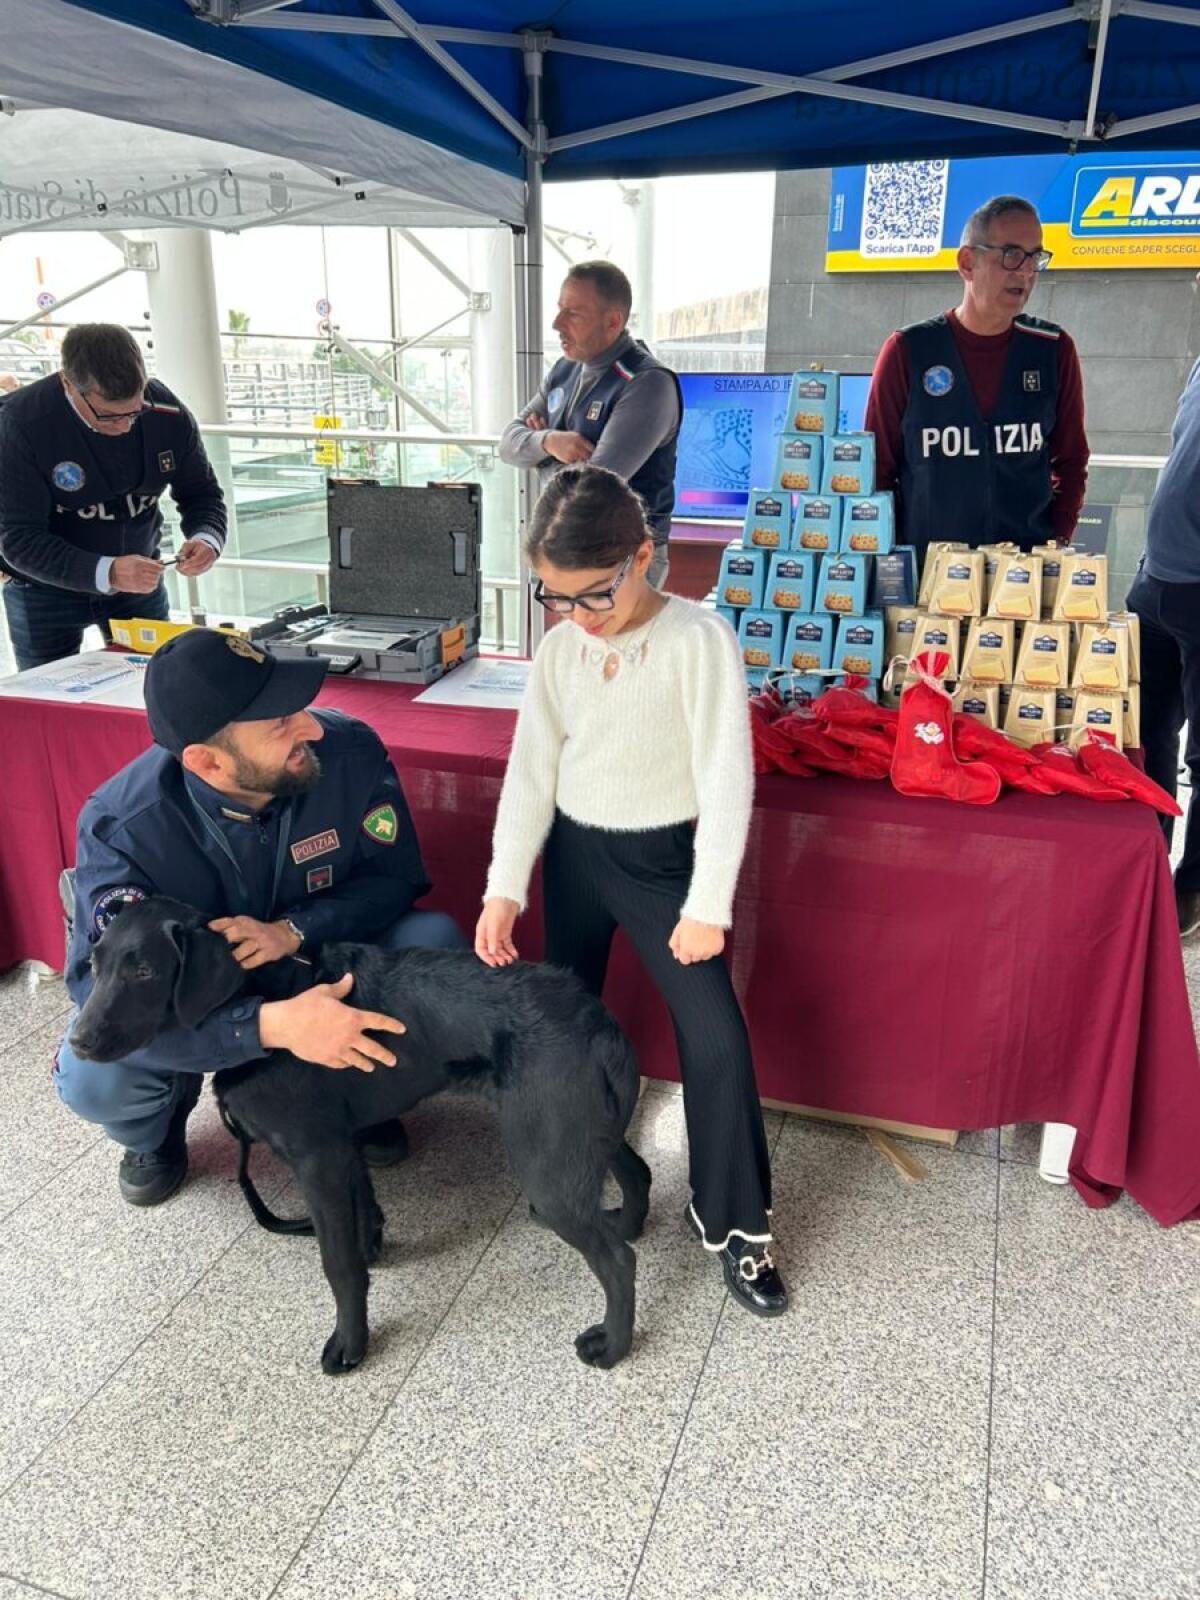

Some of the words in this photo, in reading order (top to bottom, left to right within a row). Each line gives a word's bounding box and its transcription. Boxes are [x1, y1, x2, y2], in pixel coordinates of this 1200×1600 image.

[866, 243, 905, 254] Scarica
[1071, 245, 1126, 256] CONVIENE
[1128, 244, 1163, 255] SAPER
[714, 379, 760, 391] STAMPA
[762, 379, 781, 391] AD
[295, 834, 337, 858] POLIZIA
